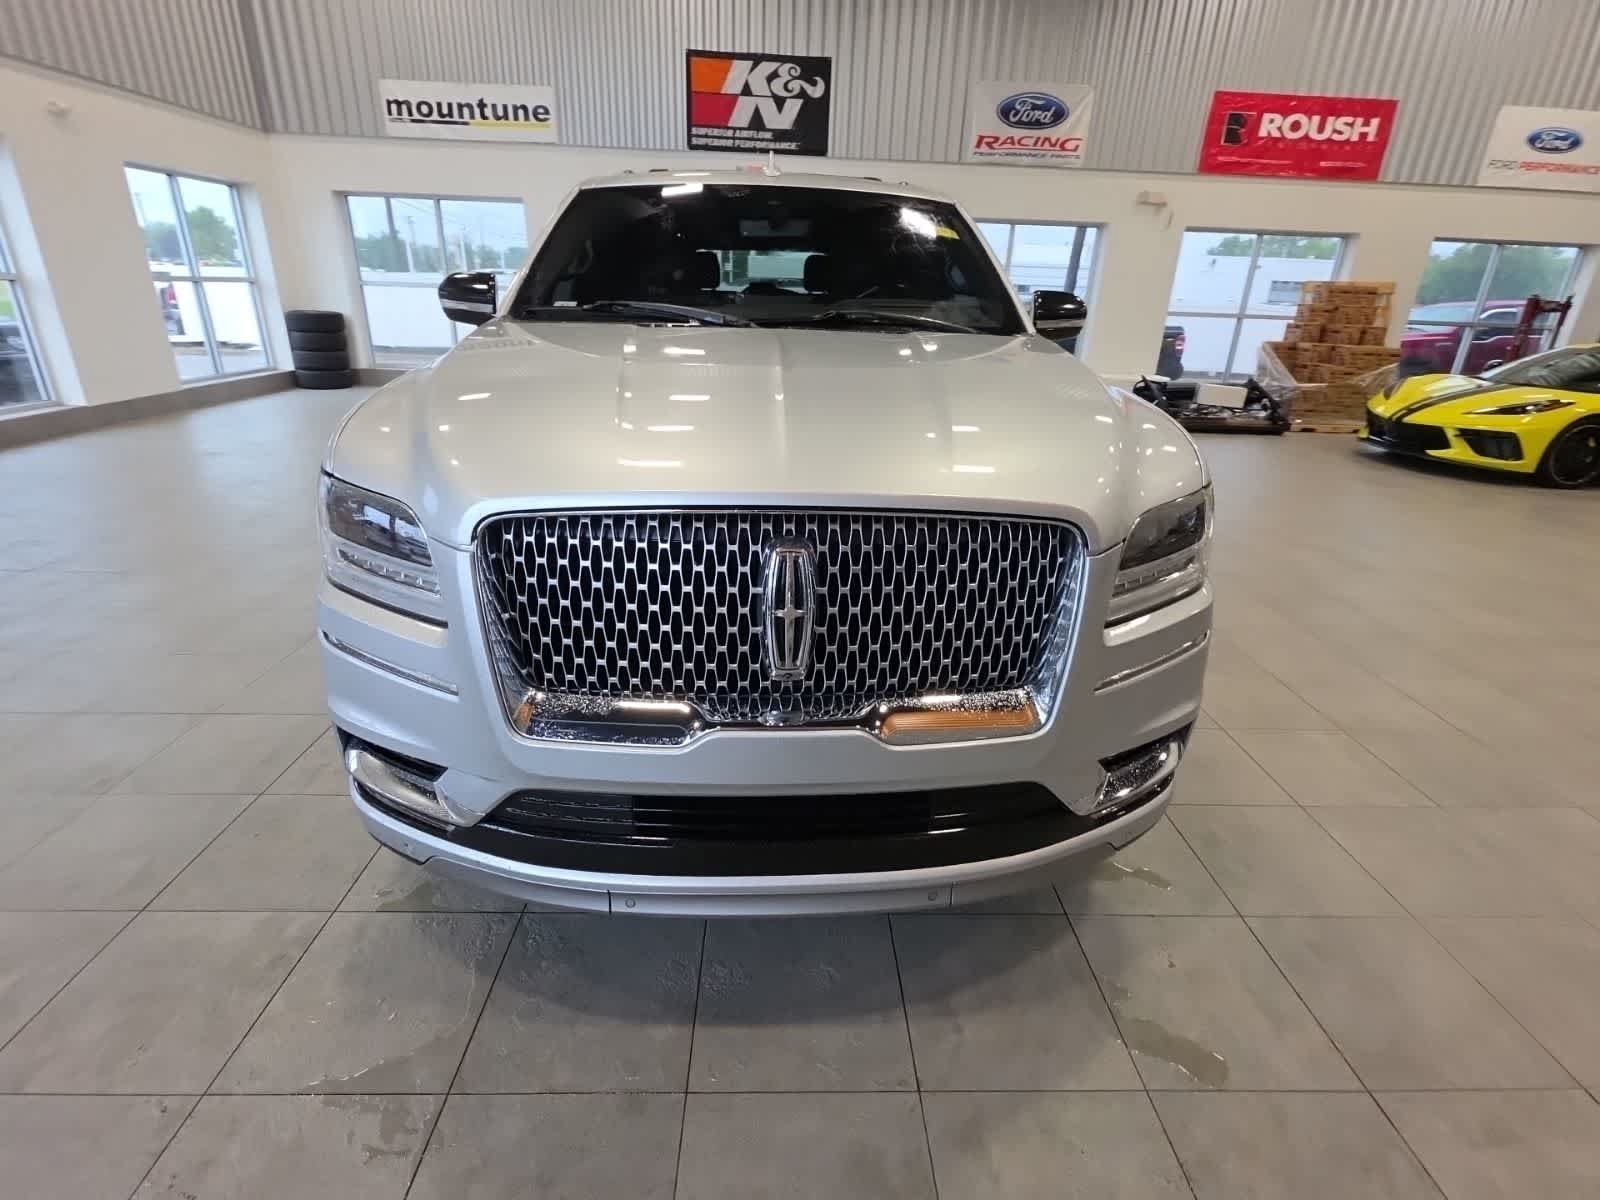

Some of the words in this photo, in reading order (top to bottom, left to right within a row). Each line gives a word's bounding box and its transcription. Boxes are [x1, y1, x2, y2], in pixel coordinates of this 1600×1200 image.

[386, 98, 551, 122] mountune
[1009, 97, 1056, 123] Ford
[1258, 112, 1381, 142] ROUSH
[975, 135, 1083, 152] RACING
